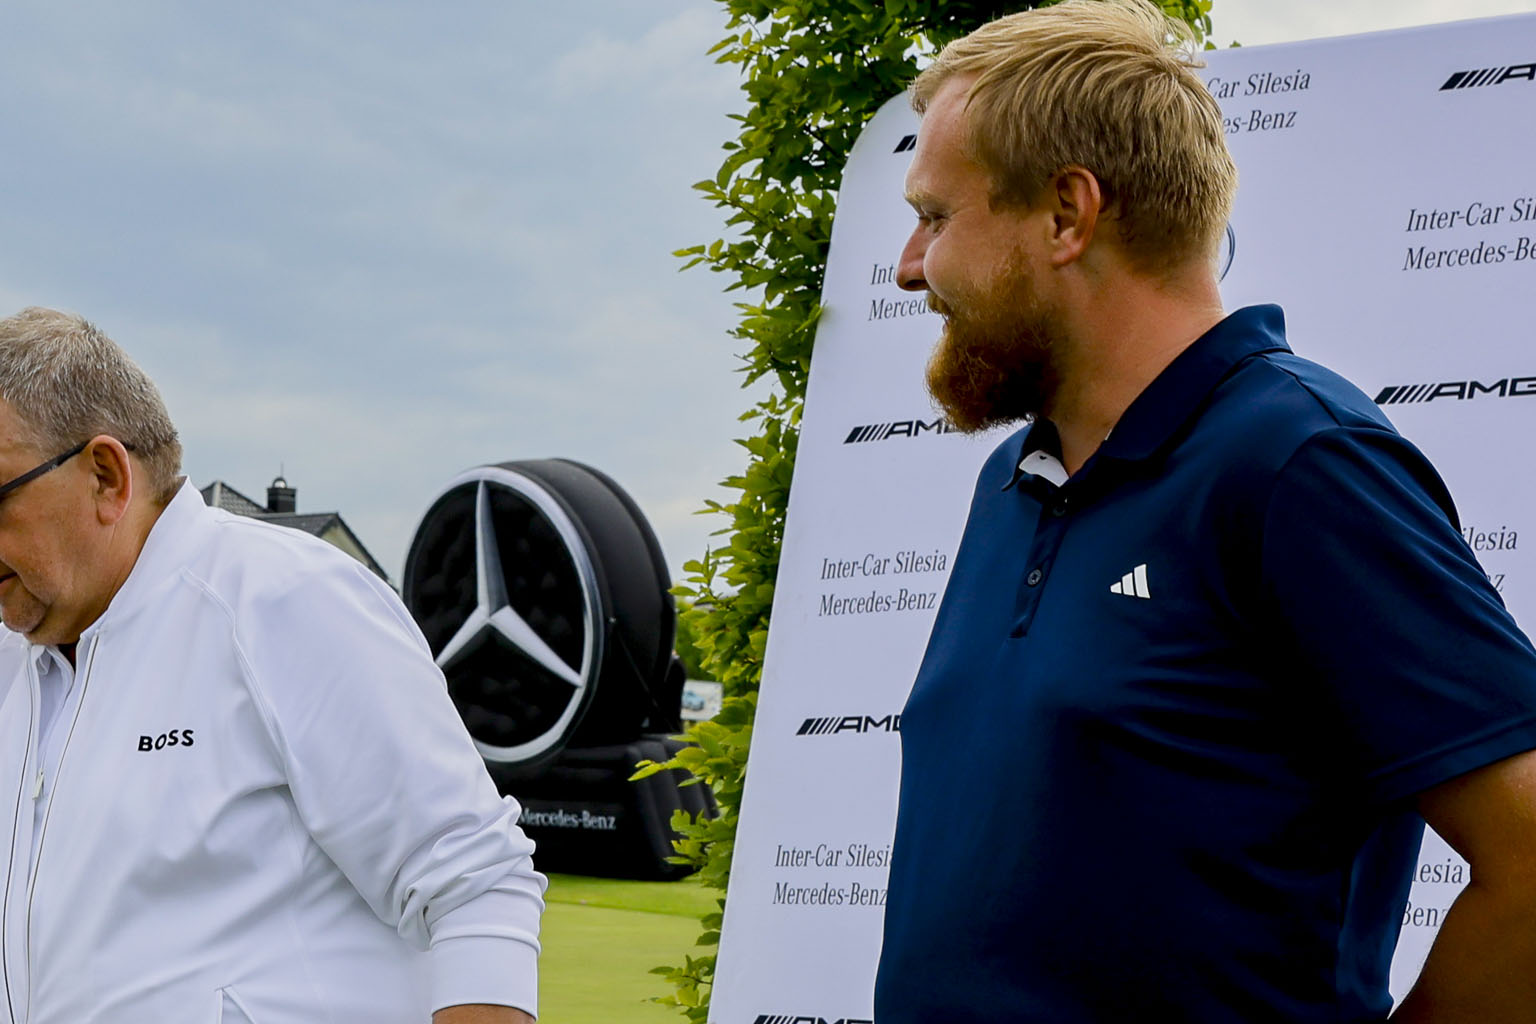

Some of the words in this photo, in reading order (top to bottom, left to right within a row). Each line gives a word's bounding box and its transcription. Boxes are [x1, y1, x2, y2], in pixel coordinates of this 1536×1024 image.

[1244, 69, 1311, 96] Silesia
[1223, 109, 1297, 134] es-Benz
[1406, 202, 1504, 232] Inter-Car
[1402, 237, 1536, 271] Mercedes-Be
[883, 418, 956, 440] AM
[821, 553, 890, 580] Inter-Car
[893, 549, 947, 574] Silesia
[818, 587, 937, 617] Mercedes-Benz
[138, 729, 194, 752] BOSS
[519, 808, 616, 829] Mercedes-Benz
[775, 843, 842, 868] Inter-Car
[772, 882, 888, 906] Mercedes-Benz
